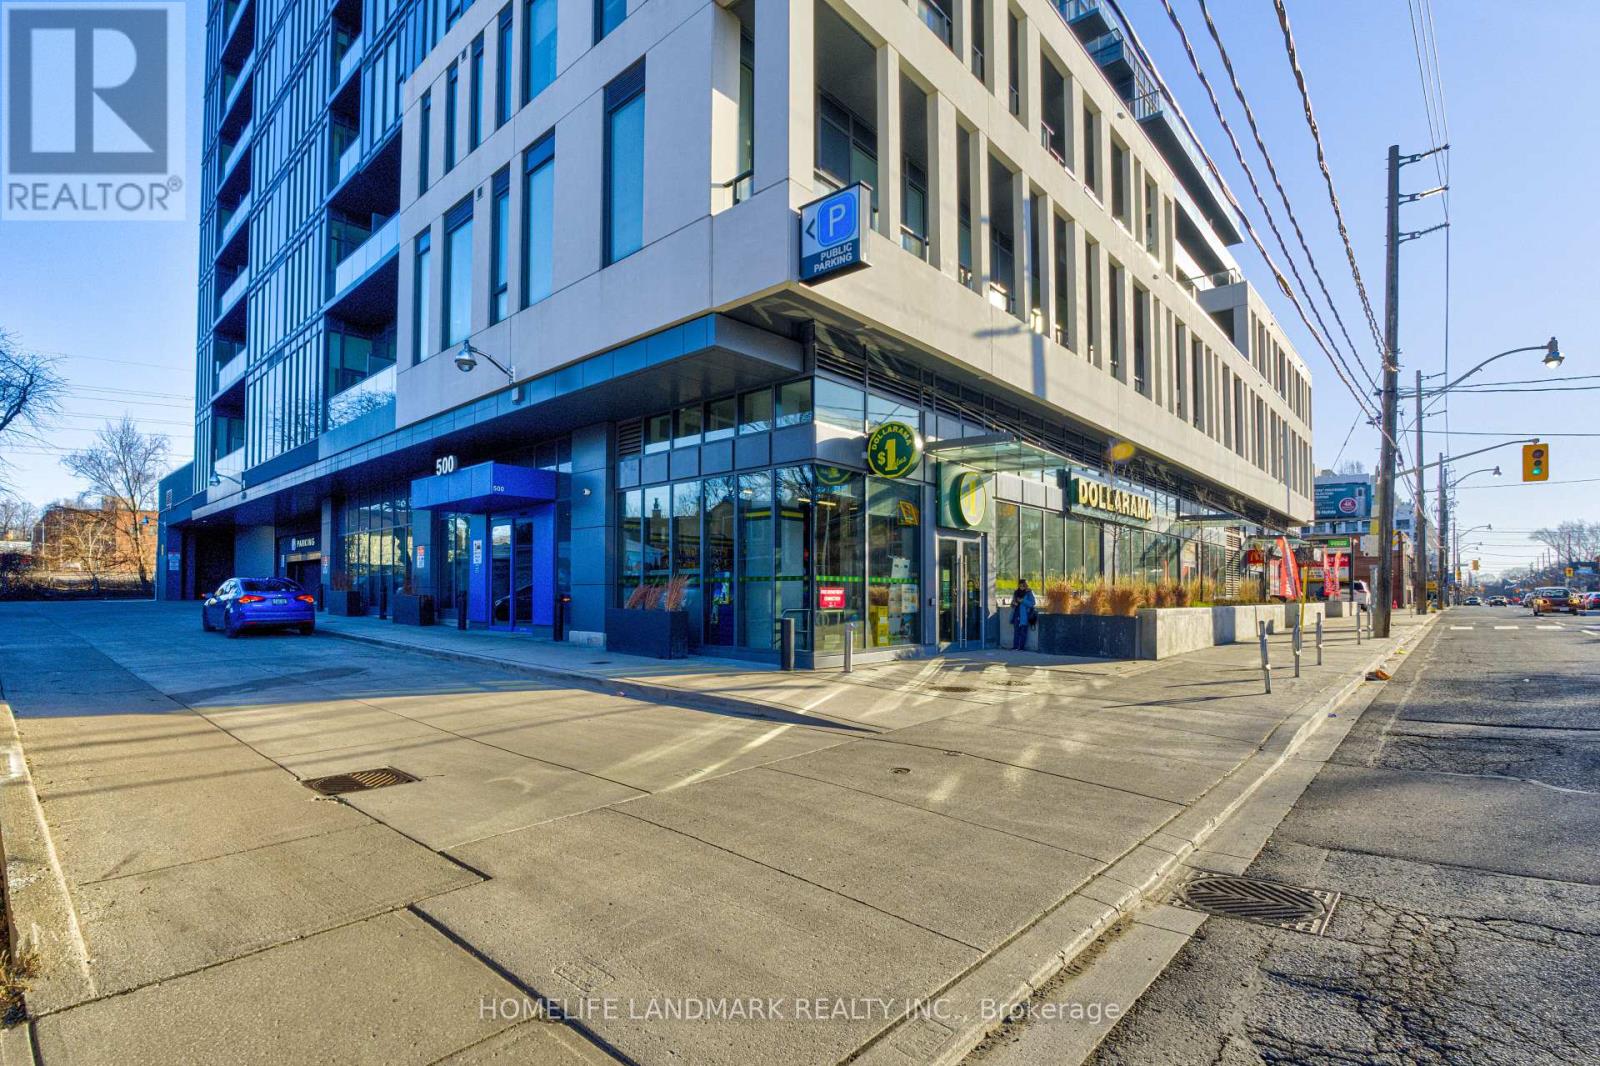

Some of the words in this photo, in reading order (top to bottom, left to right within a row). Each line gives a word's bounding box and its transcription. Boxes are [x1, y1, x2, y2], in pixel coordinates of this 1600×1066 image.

[829, 203, 846, 237] P
[820, 242, 853, 261] PUBLIC
[813, 252, 853, 273] PARKING
[871, 425, 912, 451] DOLLARAMA
[435, 455, 455, 476] 500
[492, 485, 505, 493] 500
[1078, 478, 1152, 521] DOLLARAMA
[296, 537, 316, 548] PARKING
